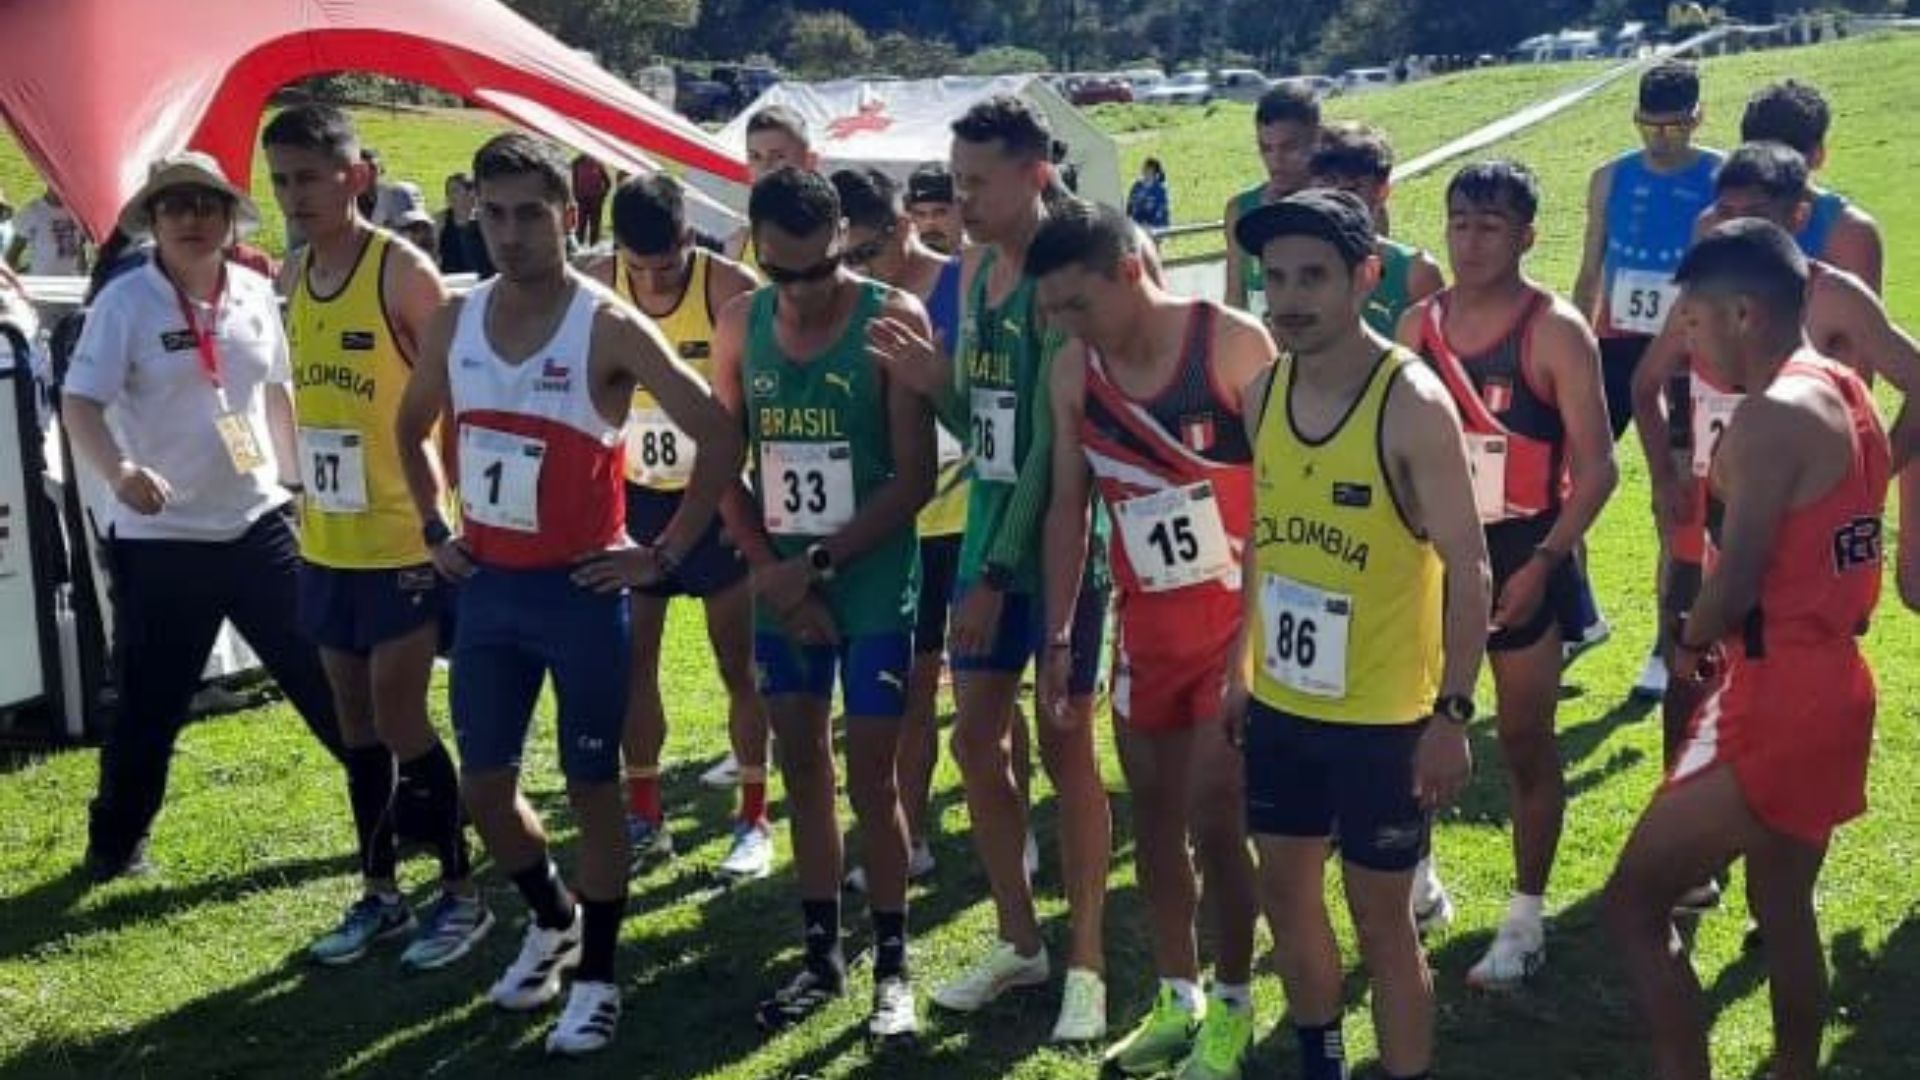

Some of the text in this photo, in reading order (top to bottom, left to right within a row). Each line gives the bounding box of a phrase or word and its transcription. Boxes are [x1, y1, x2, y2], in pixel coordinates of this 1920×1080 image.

[1628, 289, 1661, 319] 53
[760, 407, 844, 437] BRASIL
[642, 431, 677, 468] 88
[314, 453, 340, 493] 87
[484, 461, 503, 504] 1
[783, 469, 827, 514] 33
[1148, 515, 1199, 566] 15
[1276, 611, 1317, 668] 86
